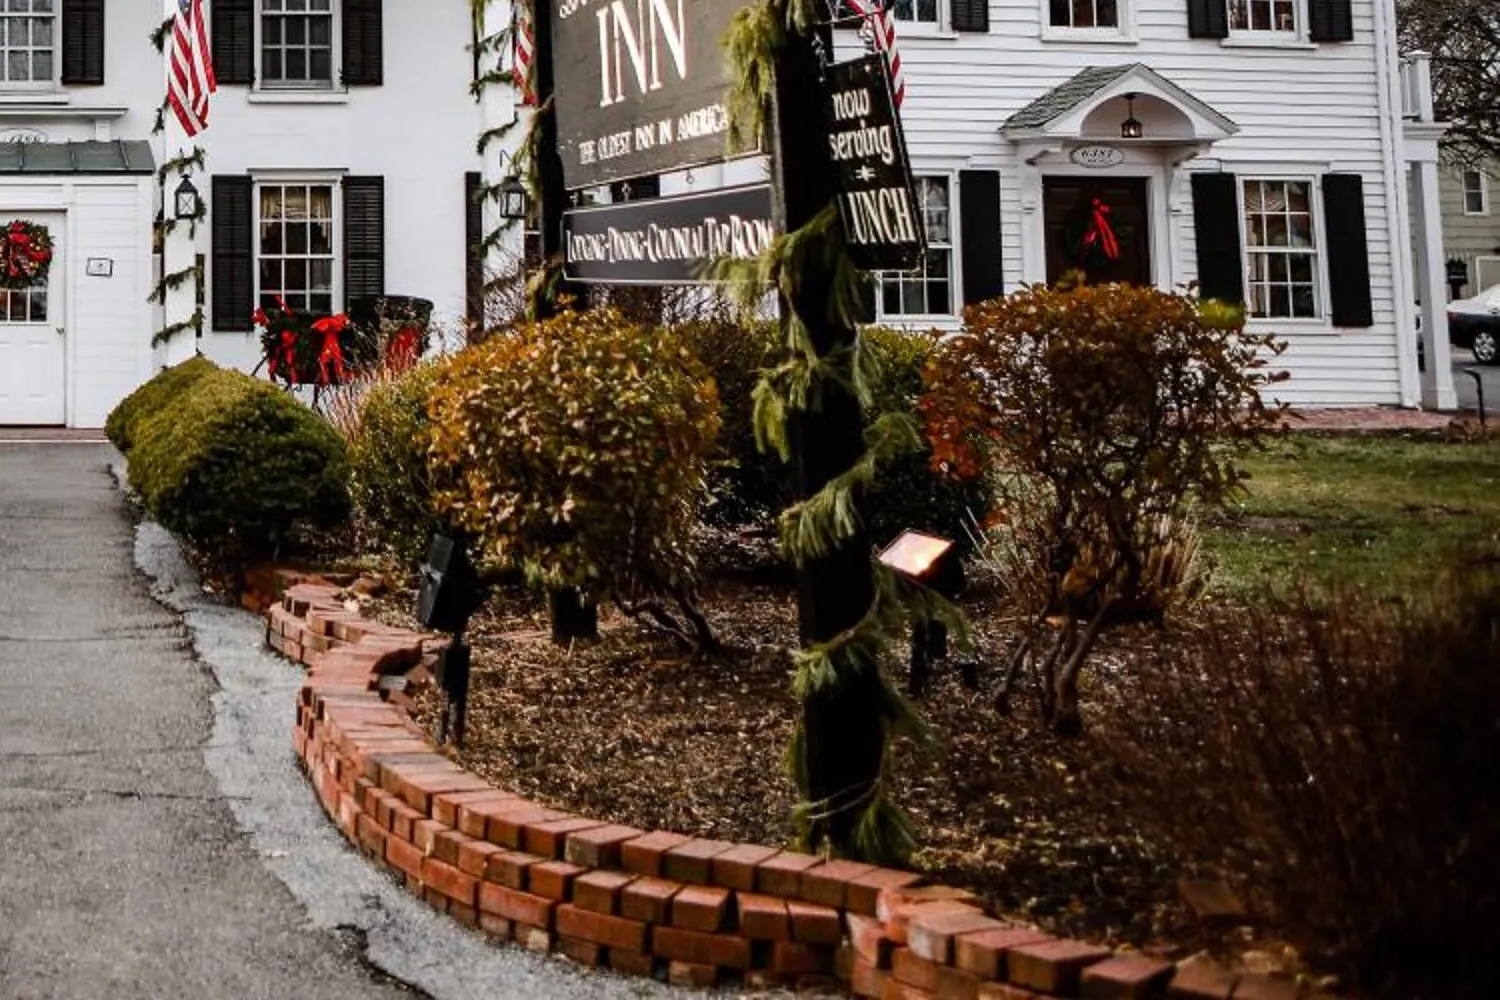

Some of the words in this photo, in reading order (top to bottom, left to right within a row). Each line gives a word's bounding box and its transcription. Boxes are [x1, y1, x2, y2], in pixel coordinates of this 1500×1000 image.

[832, 87, 871, 121] now
[579, 140, 597, 164] THE
[597, 131, 632, 160] OLDEST
[635, 123, 655, 151] INN
[658, 118, 673, 145] IN
[829, 120, 894, 165] serving
